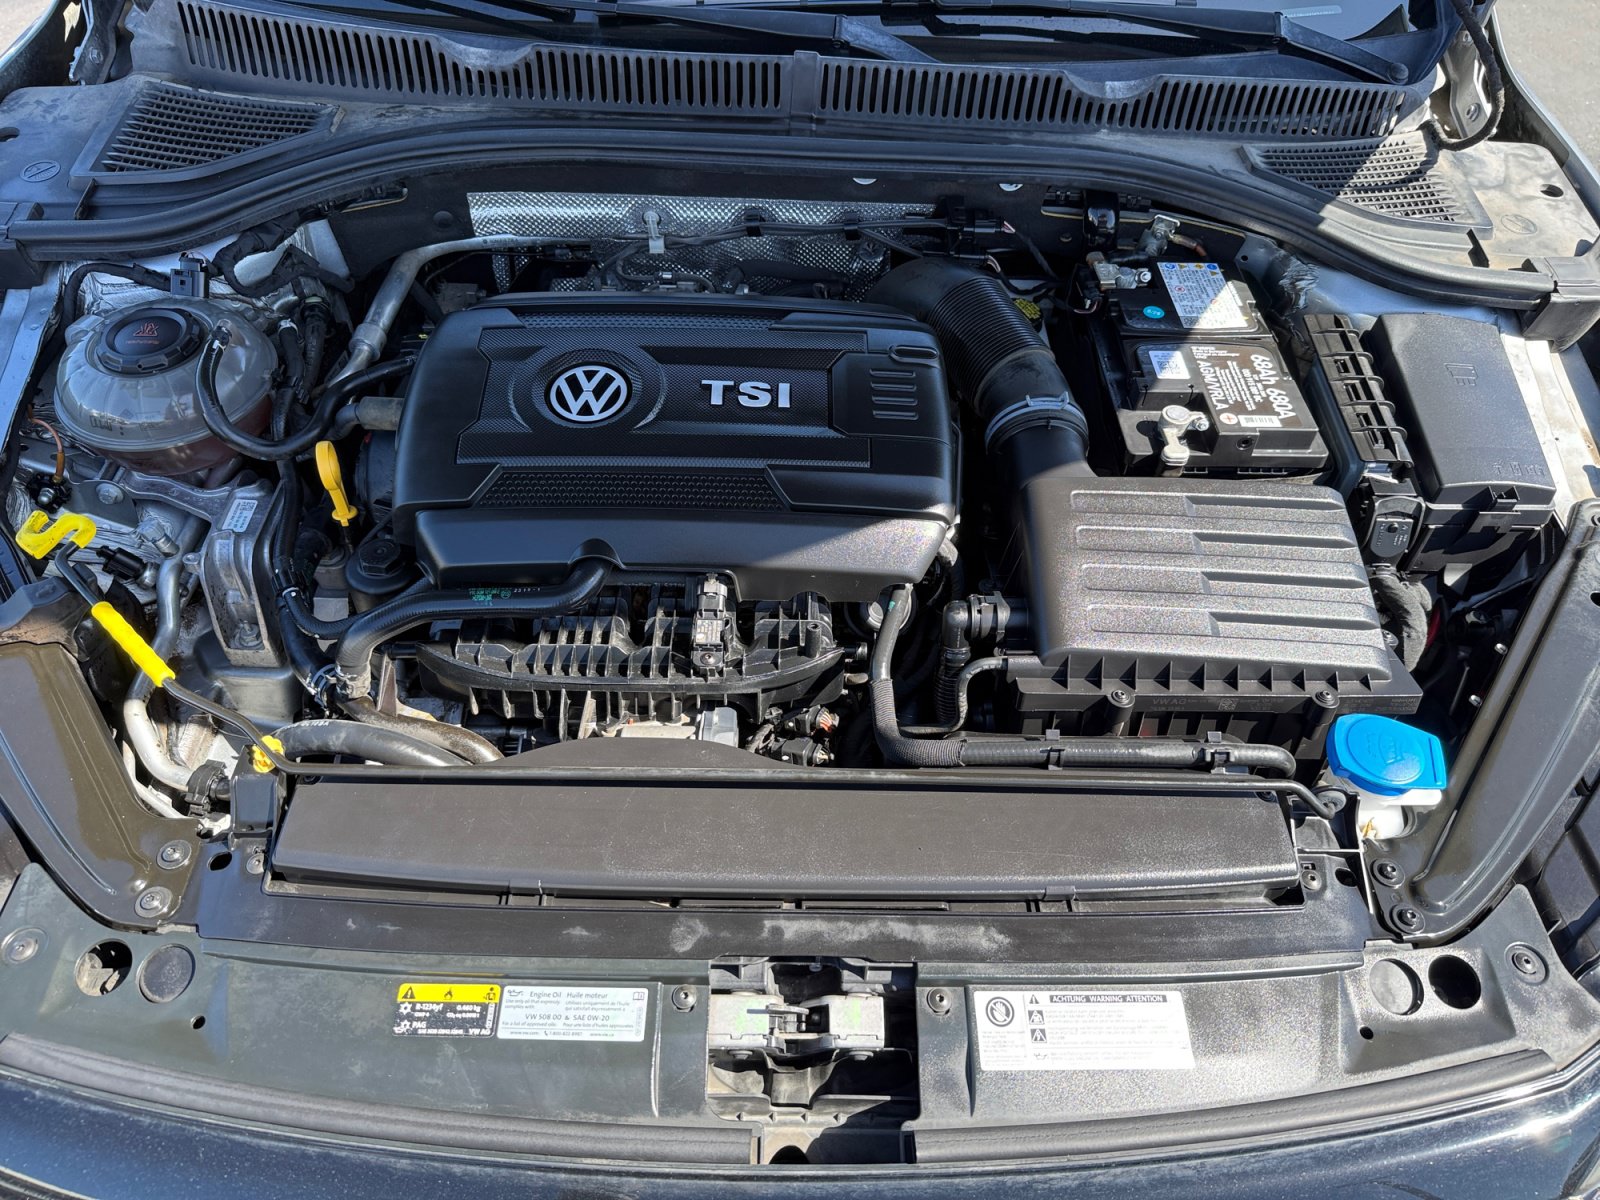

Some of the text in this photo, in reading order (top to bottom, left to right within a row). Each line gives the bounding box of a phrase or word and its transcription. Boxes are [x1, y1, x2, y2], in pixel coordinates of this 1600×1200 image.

[702, 379, 791, 408] TSI
[1196, 360, 1230, 410] AGM/VRLA
[1250, 353, 1280, 386] 68Ah
[1266, 387, 1296, 420] 680A
[530, 990, 551, 999] Engine
[1052, 994, 1086, 1002] ACHTUNG
[1126, 994, 1163, 1002] ATTENTION
[415, 1003, 444, 1012] R-1234yf
